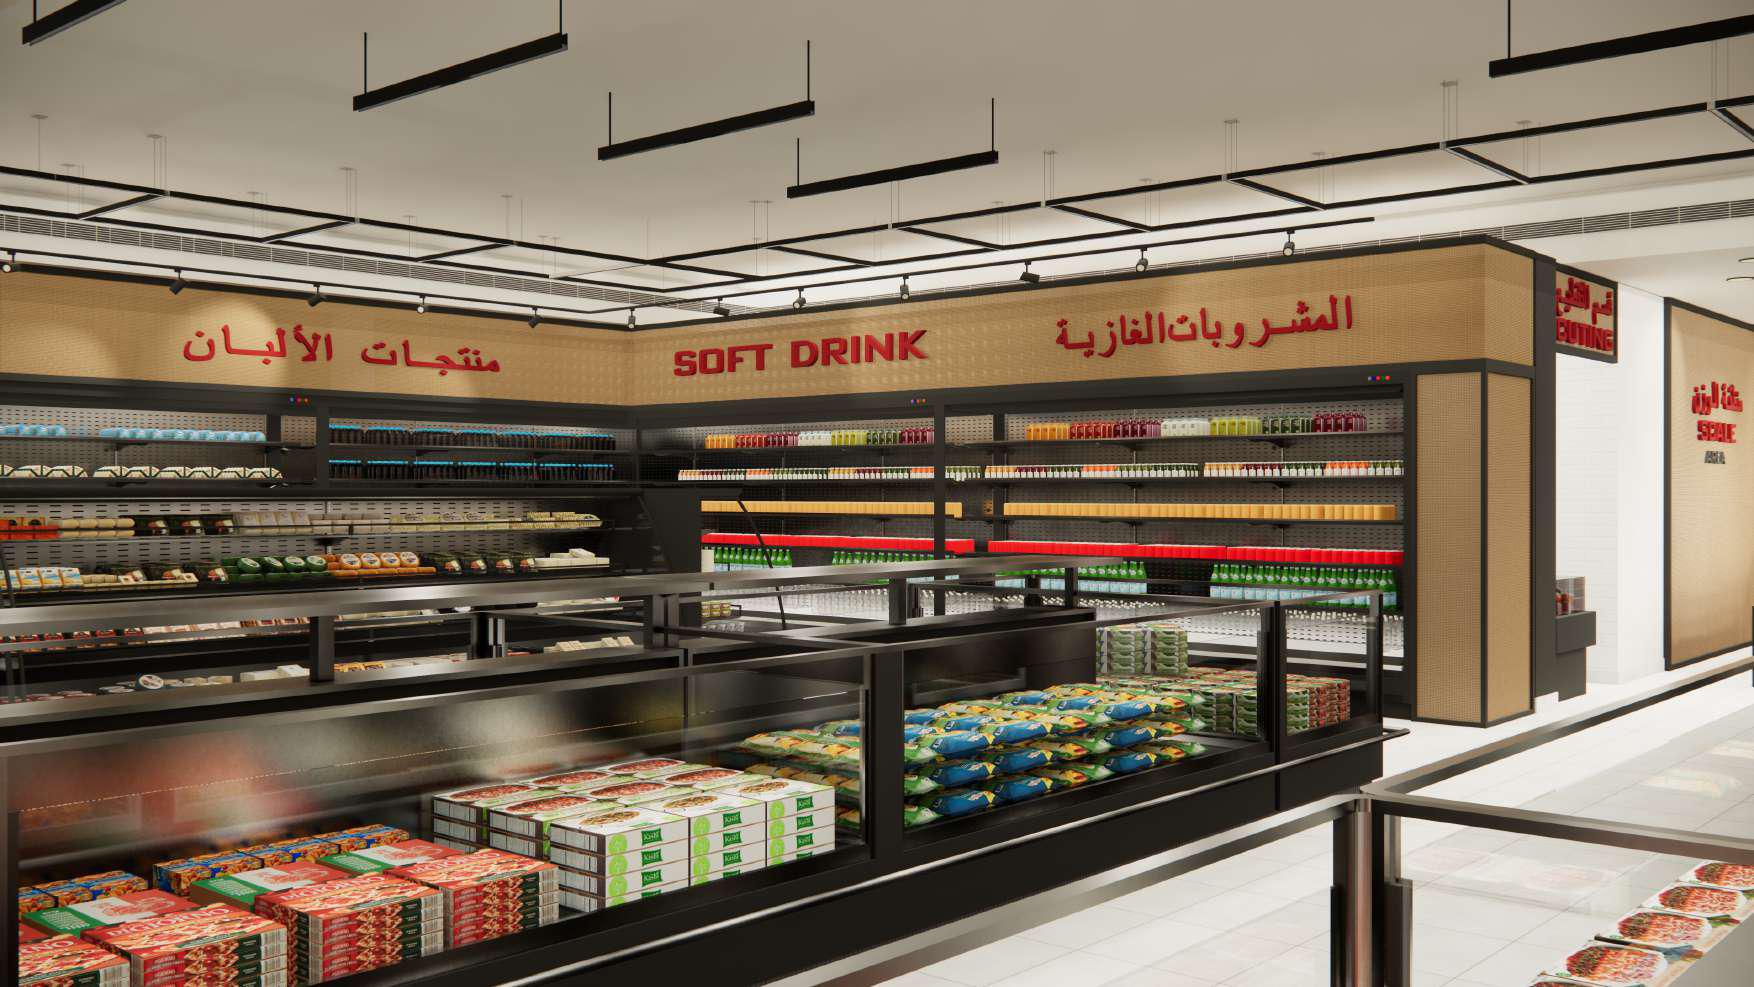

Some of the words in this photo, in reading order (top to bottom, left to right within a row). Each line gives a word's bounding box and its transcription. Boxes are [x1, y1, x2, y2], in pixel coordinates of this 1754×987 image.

[183, 322, 334, 365] الألبان
[1056, 312, 1166, 358] الغازية
[1167, 295, 1353, 349] المشروبات
[361, 340, 501, 376] منتجات
[673, 343, 774, 377] SOFT
[790, 329, 928, 369] DRINK
[1697, 420, 1736, 444] SCALE
